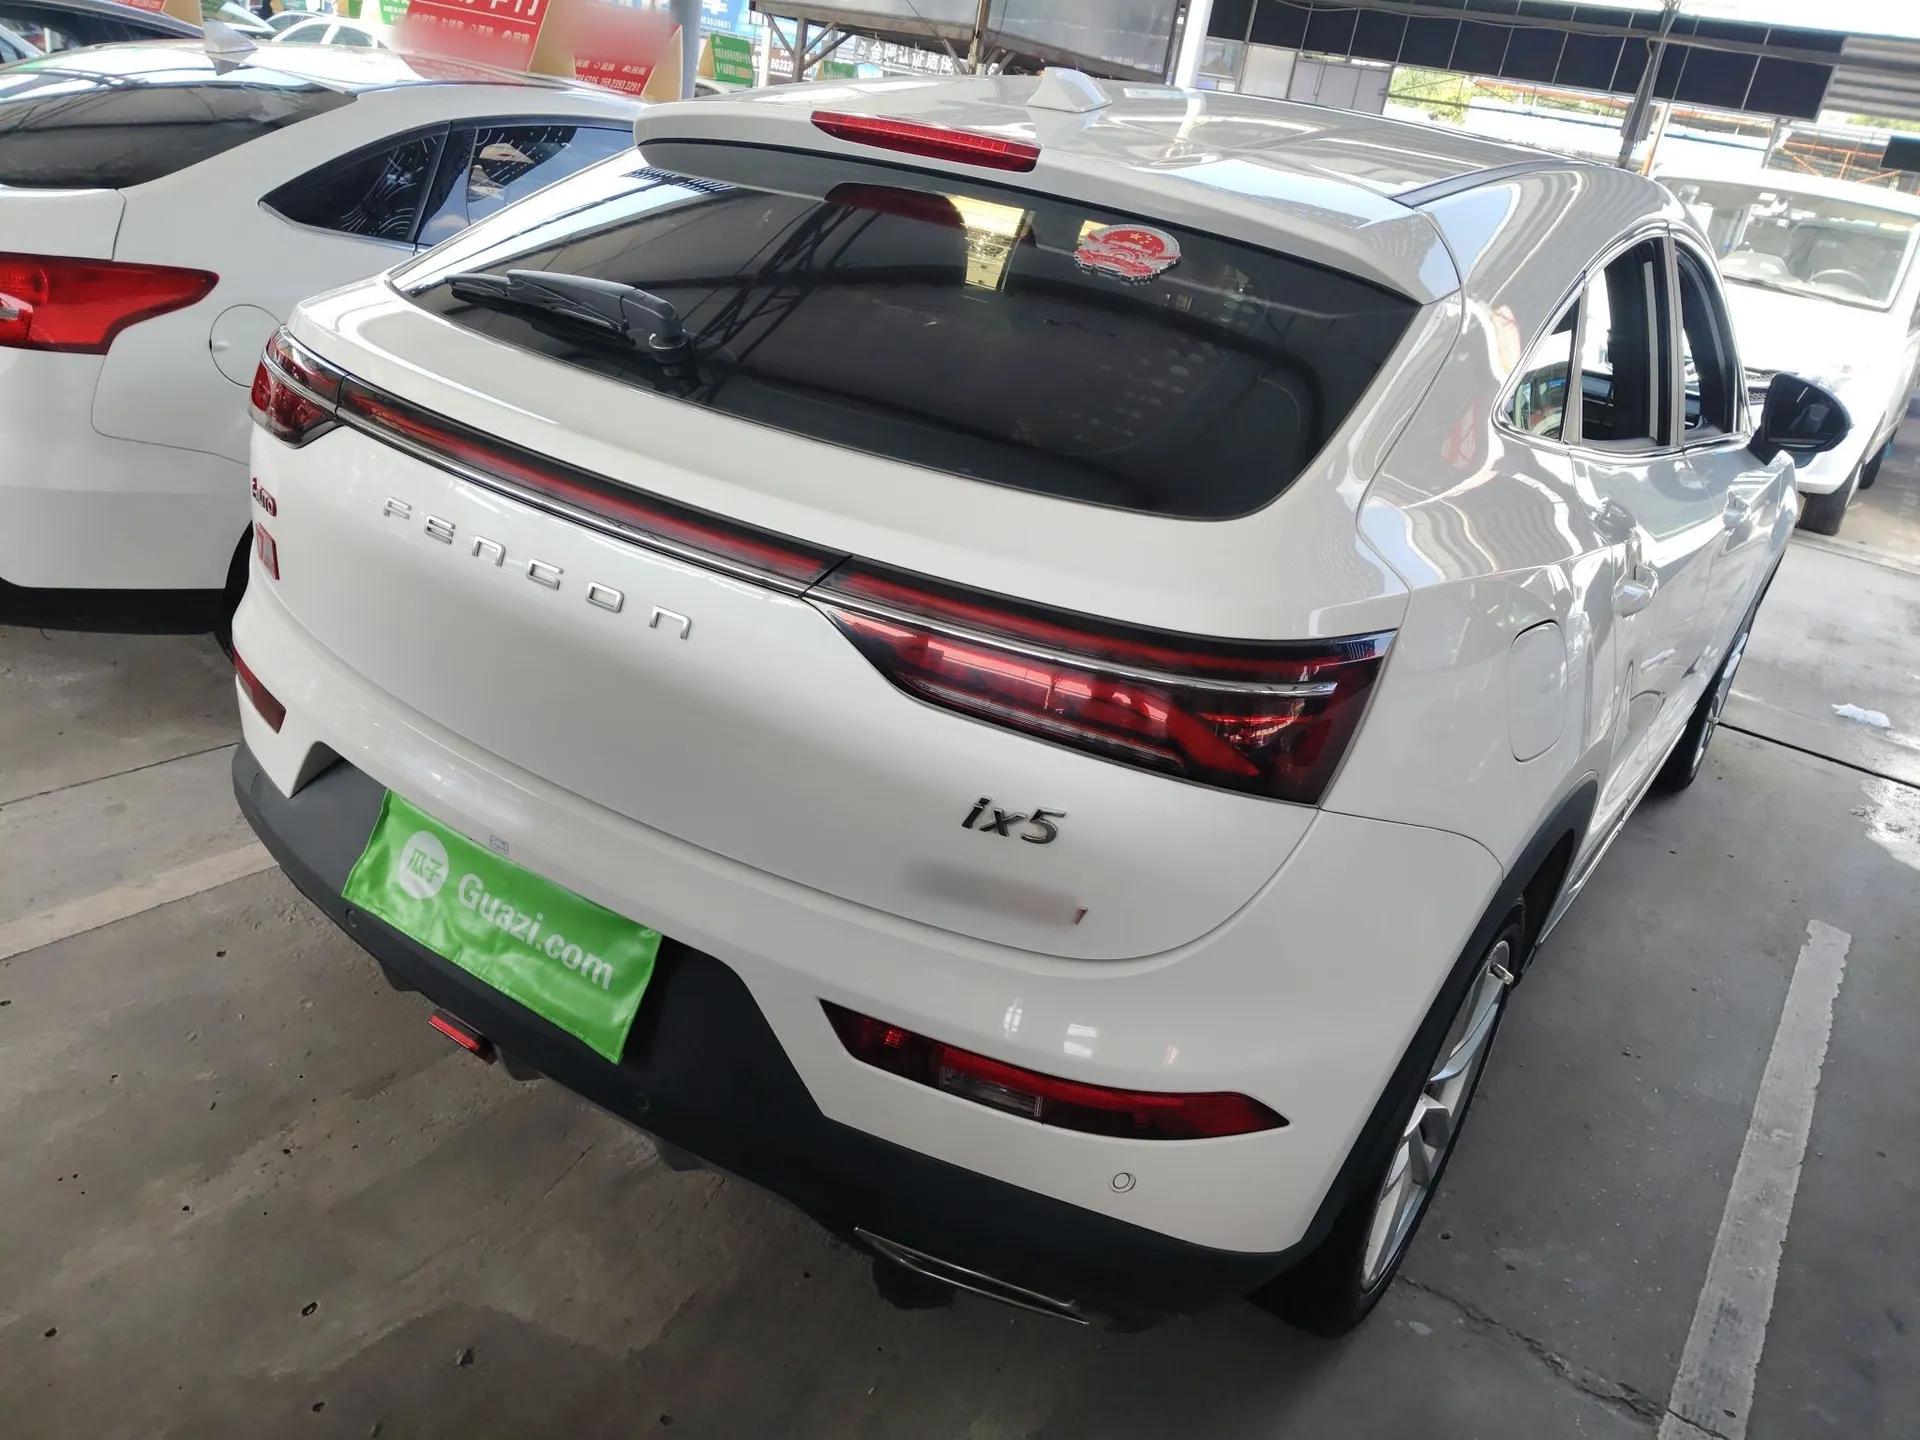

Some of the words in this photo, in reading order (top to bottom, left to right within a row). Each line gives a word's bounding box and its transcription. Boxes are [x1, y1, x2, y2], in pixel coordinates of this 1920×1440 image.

[962, 797, 1066, 844] ix5
[406, 847, 443, 884] 瓜子
[458, 873, 614, 990] Guazi.com
